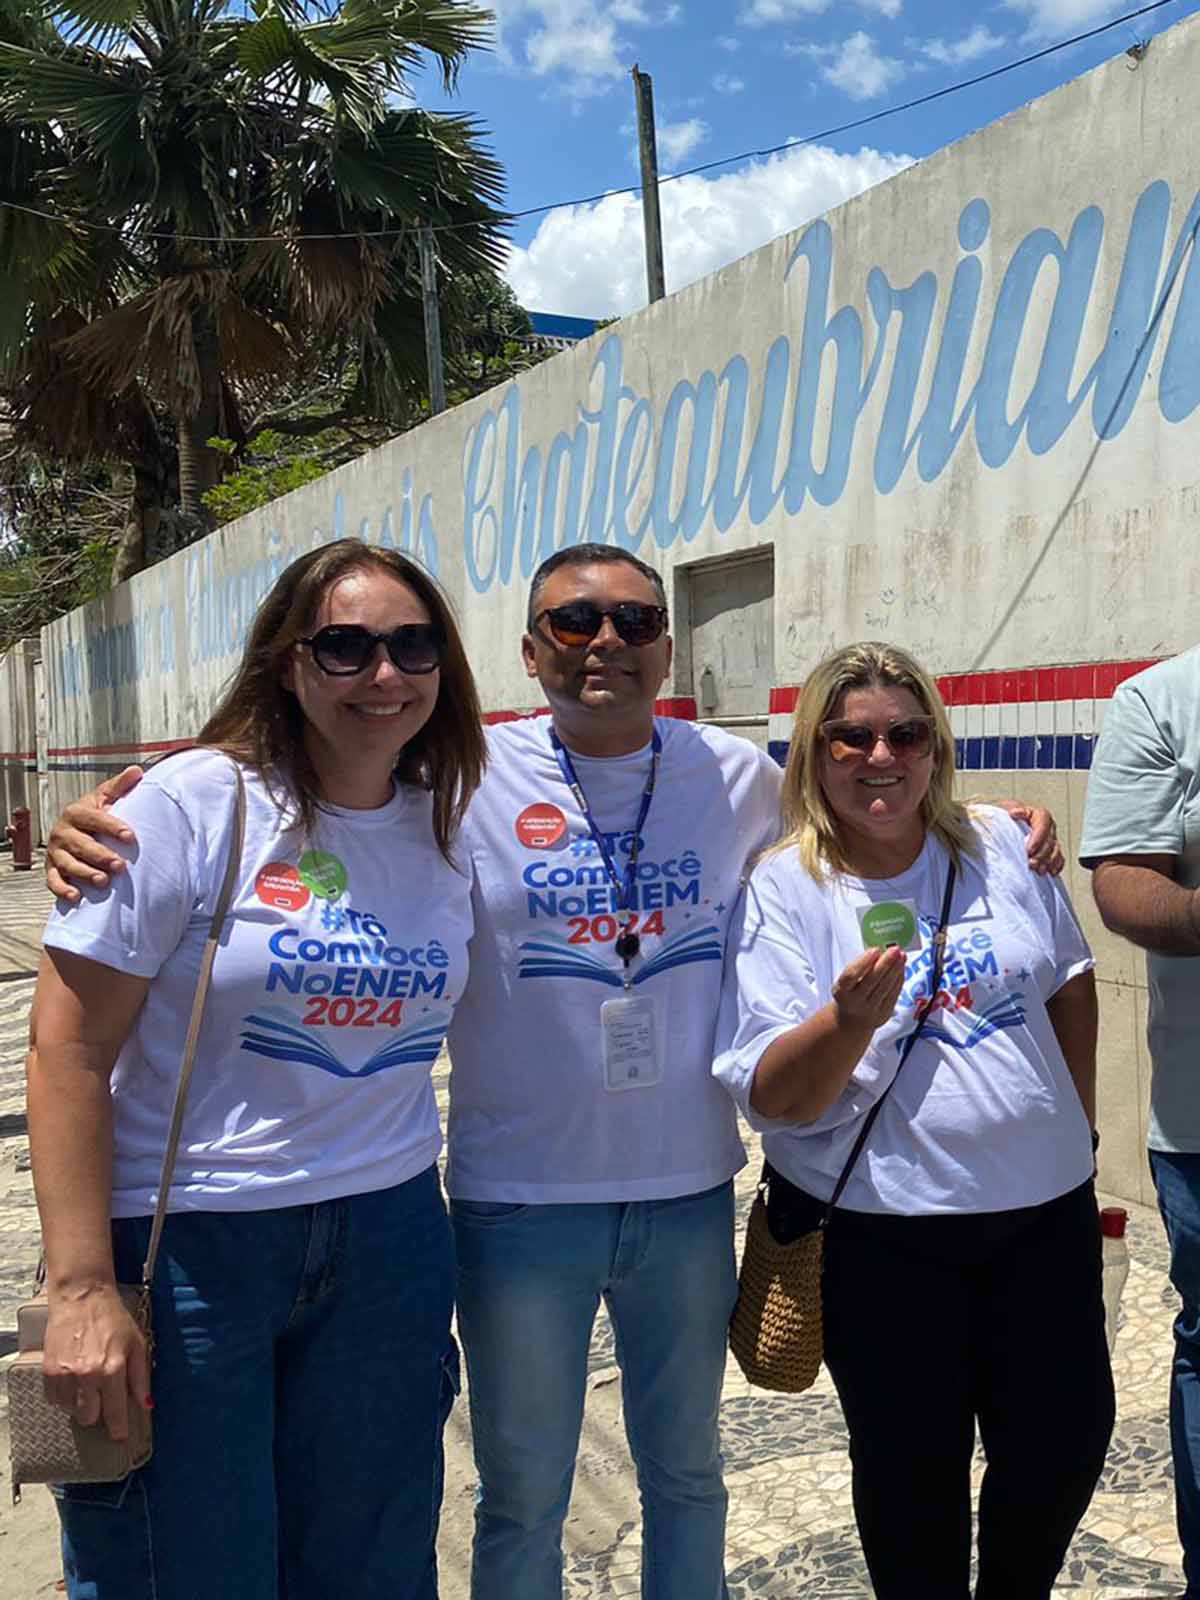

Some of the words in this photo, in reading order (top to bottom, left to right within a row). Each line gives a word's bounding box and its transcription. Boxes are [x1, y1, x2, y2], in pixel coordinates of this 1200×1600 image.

[321, 904, 388, 937] #Tô
[268, 928, 450, 969] ComVocê
[265, 962, 448, 1000] NoENEM
[302, 996, 404, 1028] 2024
